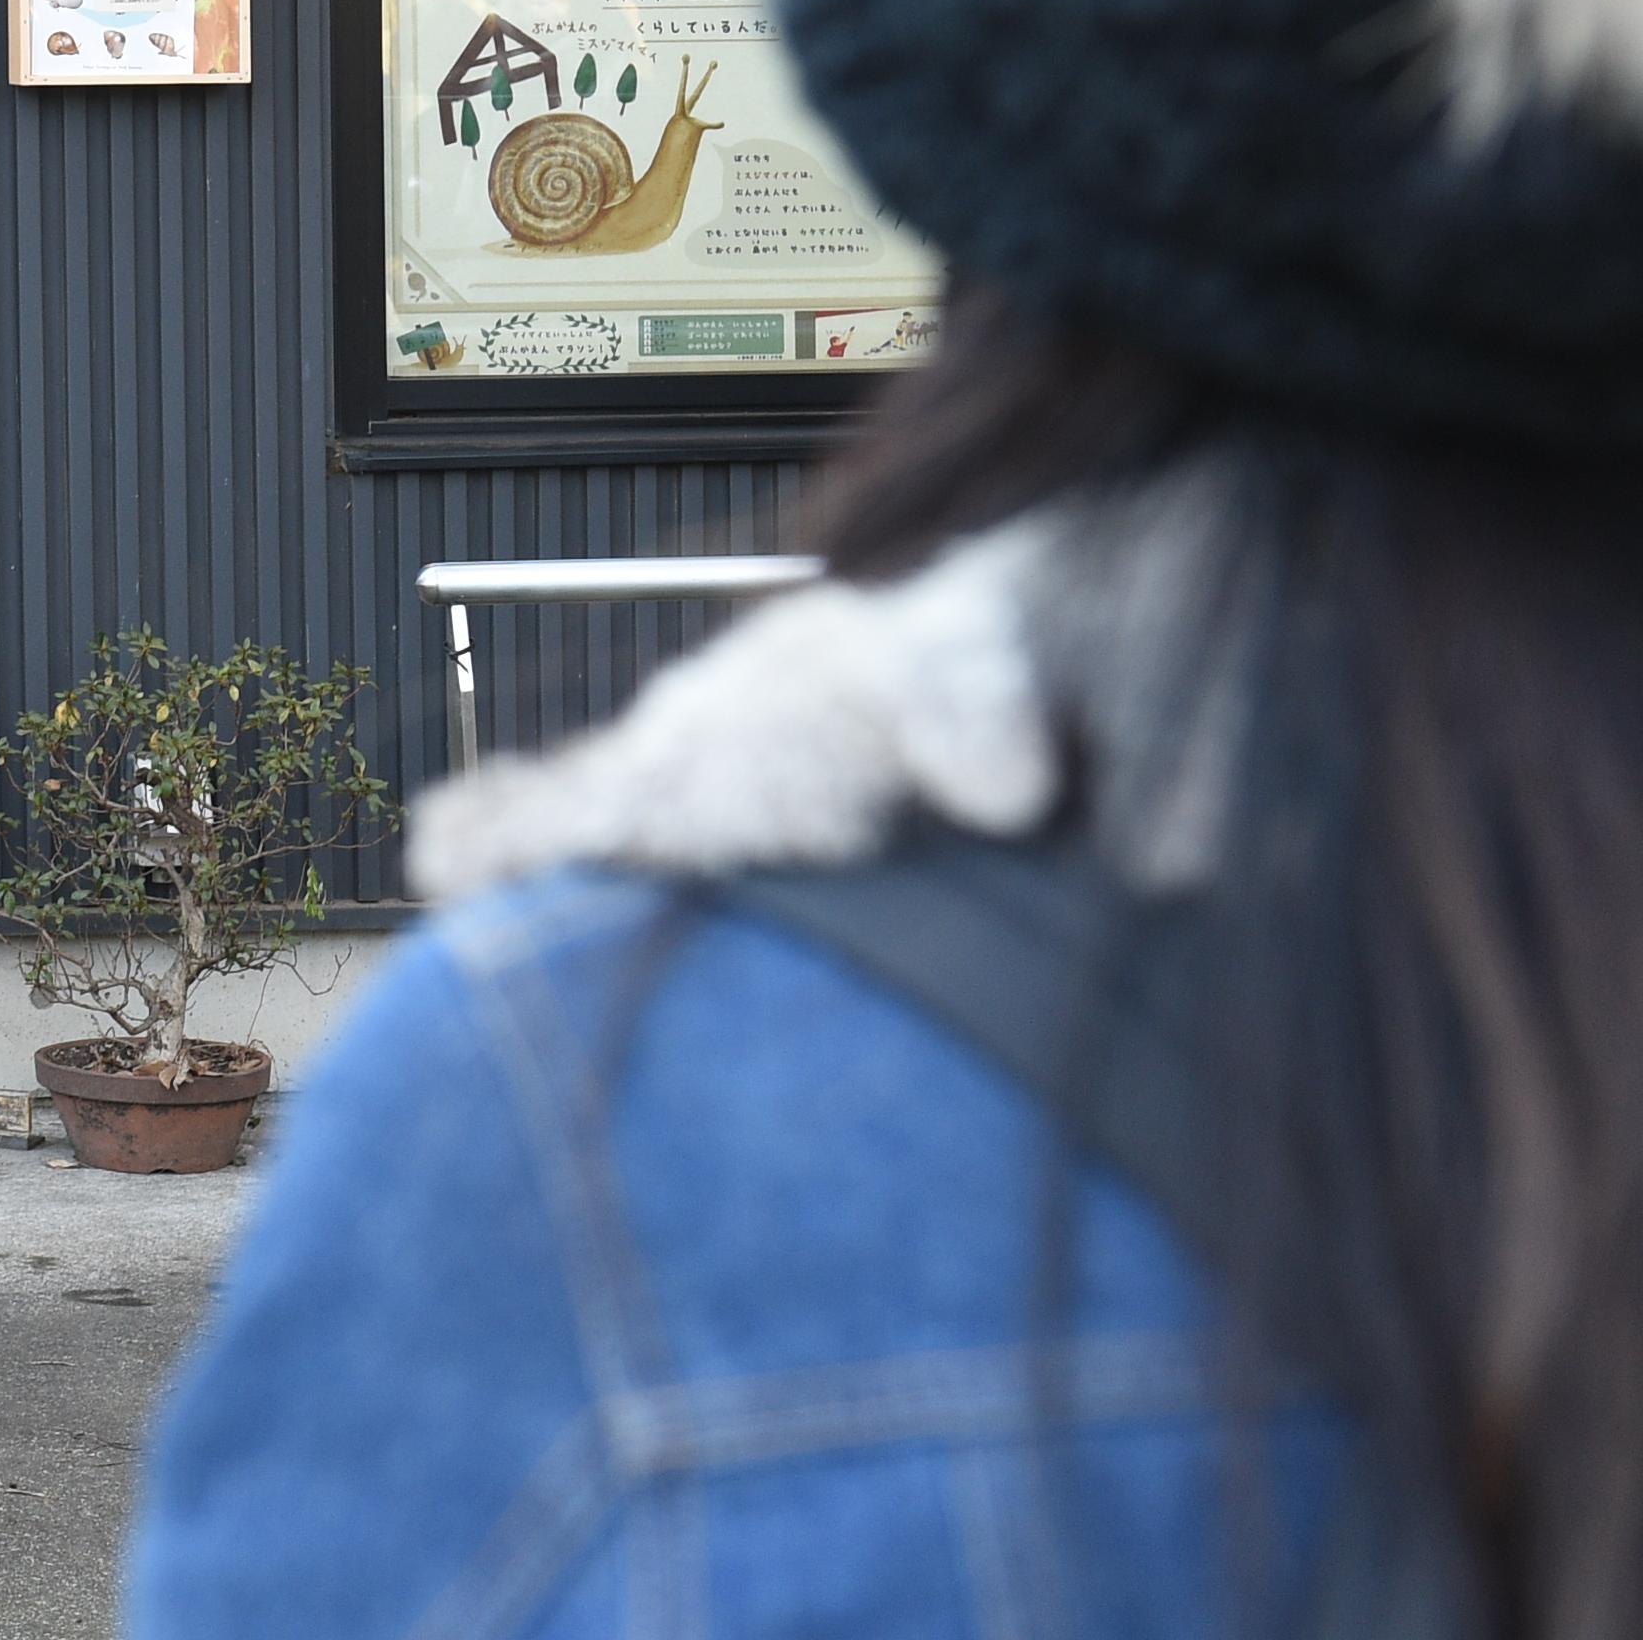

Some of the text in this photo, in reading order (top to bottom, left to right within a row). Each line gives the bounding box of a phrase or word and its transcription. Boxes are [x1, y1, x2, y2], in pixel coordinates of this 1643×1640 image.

[637, 20, 778, 34] くらしているんだ。
[499, 345, 549, 355] ぶんかえん
